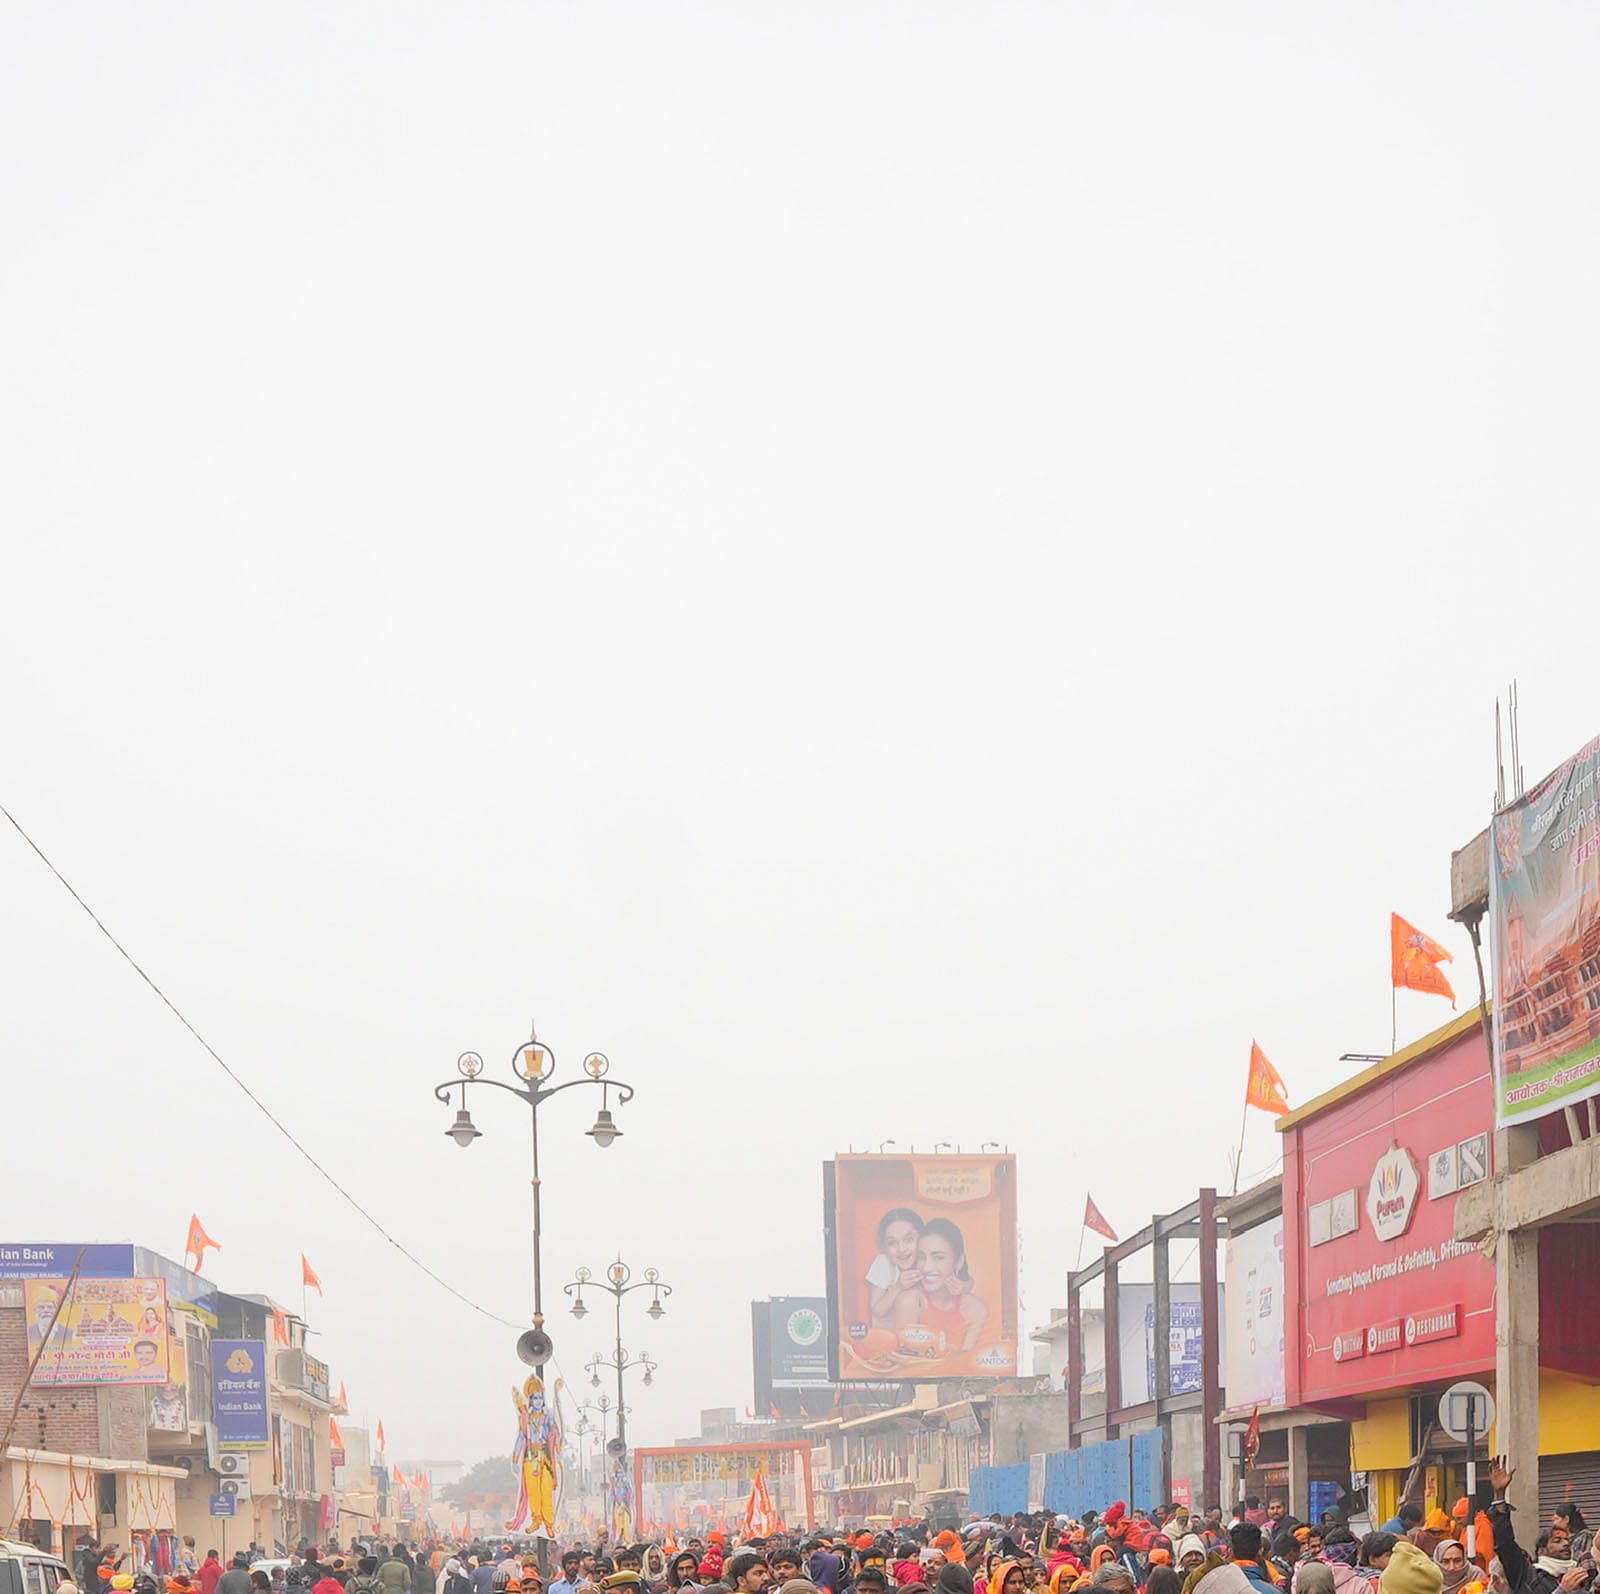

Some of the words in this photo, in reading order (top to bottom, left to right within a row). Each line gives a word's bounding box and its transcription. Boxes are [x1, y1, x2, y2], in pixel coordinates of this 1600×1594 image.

[1506, 1079, 1548, 1104] आयोजक
[22, 1247, 55, 1260] Bank
[1372, 1257, 1397, 1283] Personal
[1416, 1312, 1457, 1337] RESTAURANT
[976, 1357, 1013, 1366] SANTOOR
[218, 1402, 242, 1410] Indian
[243, 1402, 265, 1410] Bank
